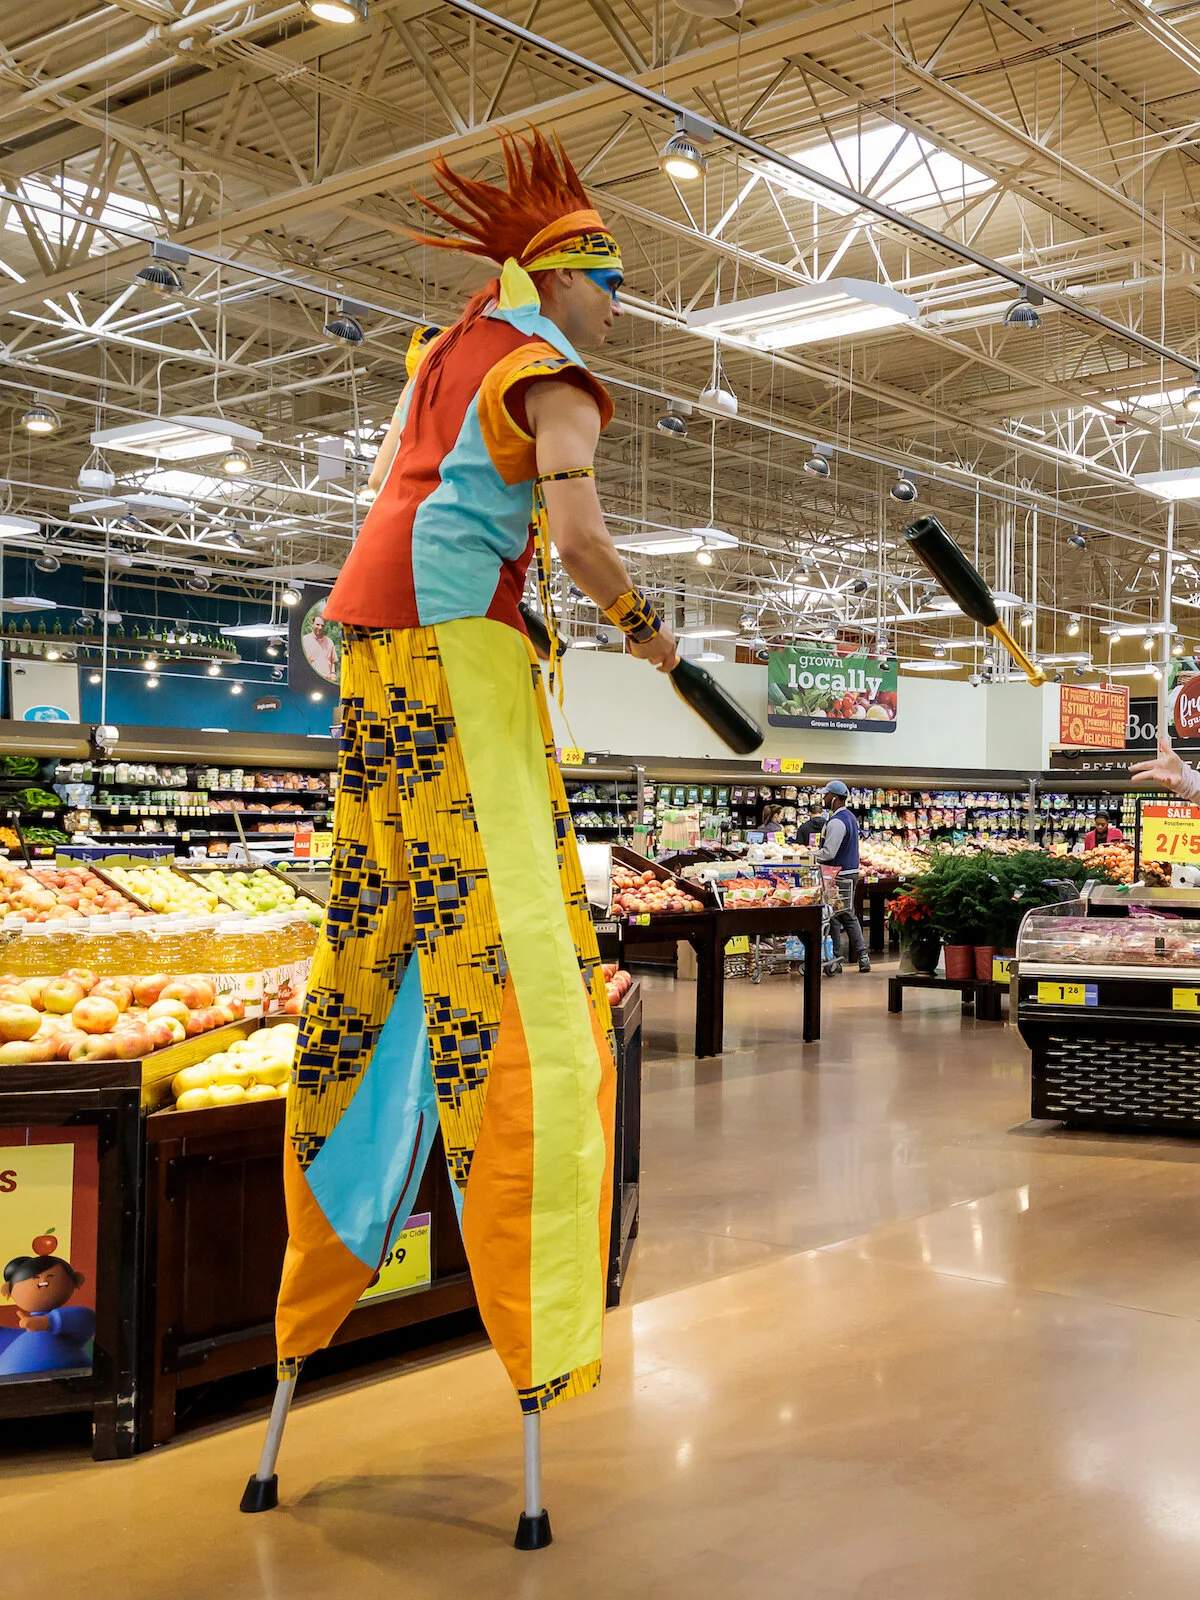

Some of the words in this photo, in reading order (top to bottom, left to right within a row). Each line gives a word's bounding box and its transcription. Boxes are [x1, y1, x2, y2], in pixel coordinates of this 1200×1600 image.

[799, 655, 843, 668] grown
[788, 664, 883, 701] locally
[1089, 691, 1109, 706] SOFT
[1067, 701, 1094, 717] STINKY
[810, 719, 829, 728] Grown
[829, 720, 836, 728] in
[836, 720, 858, 730] Georgia
[1084, 732, 1112, 747] DELICATE
[1167, 807, 1192, 819] SALE
[296, 841, 310, 849] SALE
[409, 1228, 428, 1238] Cider
